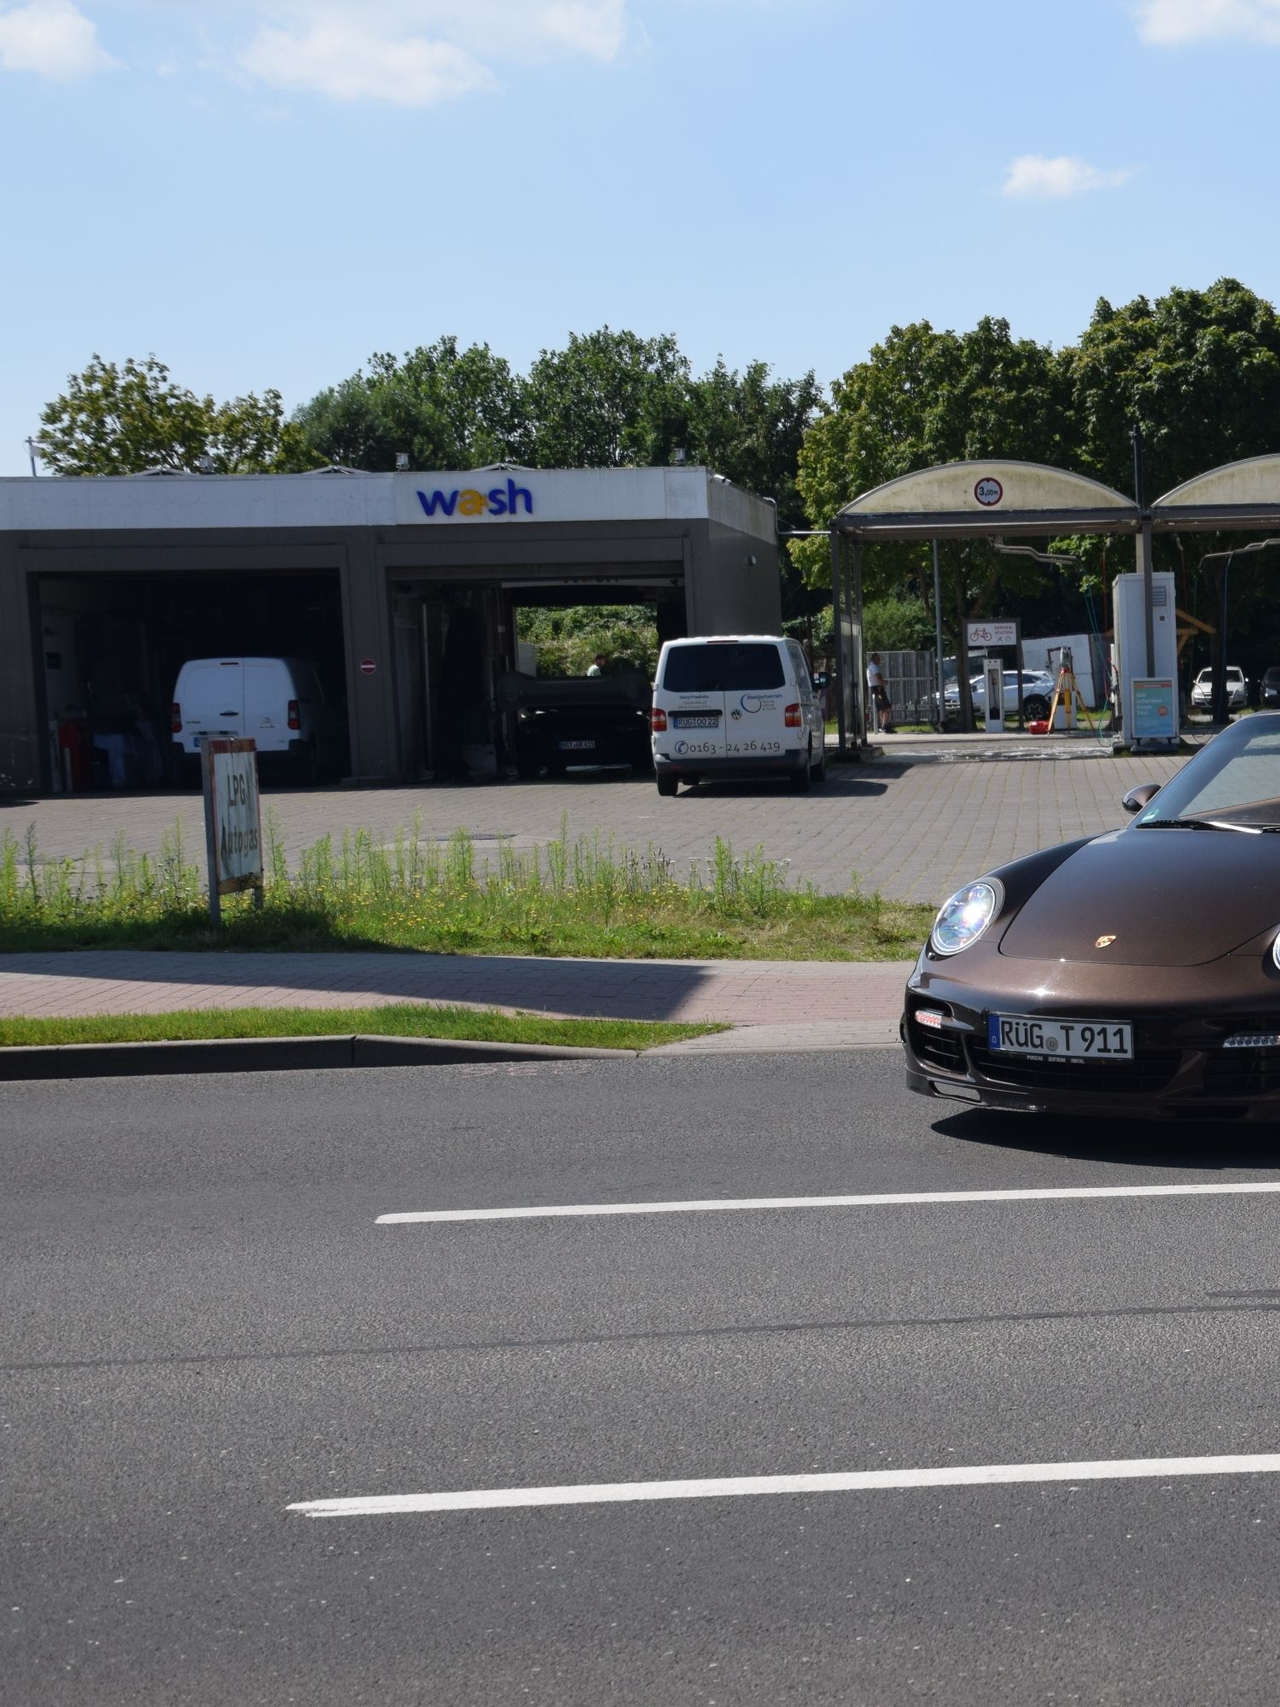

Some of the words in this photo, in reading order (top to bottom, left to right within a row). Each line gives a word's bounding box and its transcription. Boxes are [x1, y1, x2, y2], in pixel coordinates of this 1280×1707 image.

[416, 478, 533, 517] wash
[690, 742, 717, 755] 0163
[727, 743, 740, 753] 24
[744, 740, 757, 751] 26
[760, 741, 780, 752] 419
[1001, 1020, 1044, 1049] RÜG
[1060, 1025, 1075, 1051] T
[1080, 1026, 1128, 1054] 911
